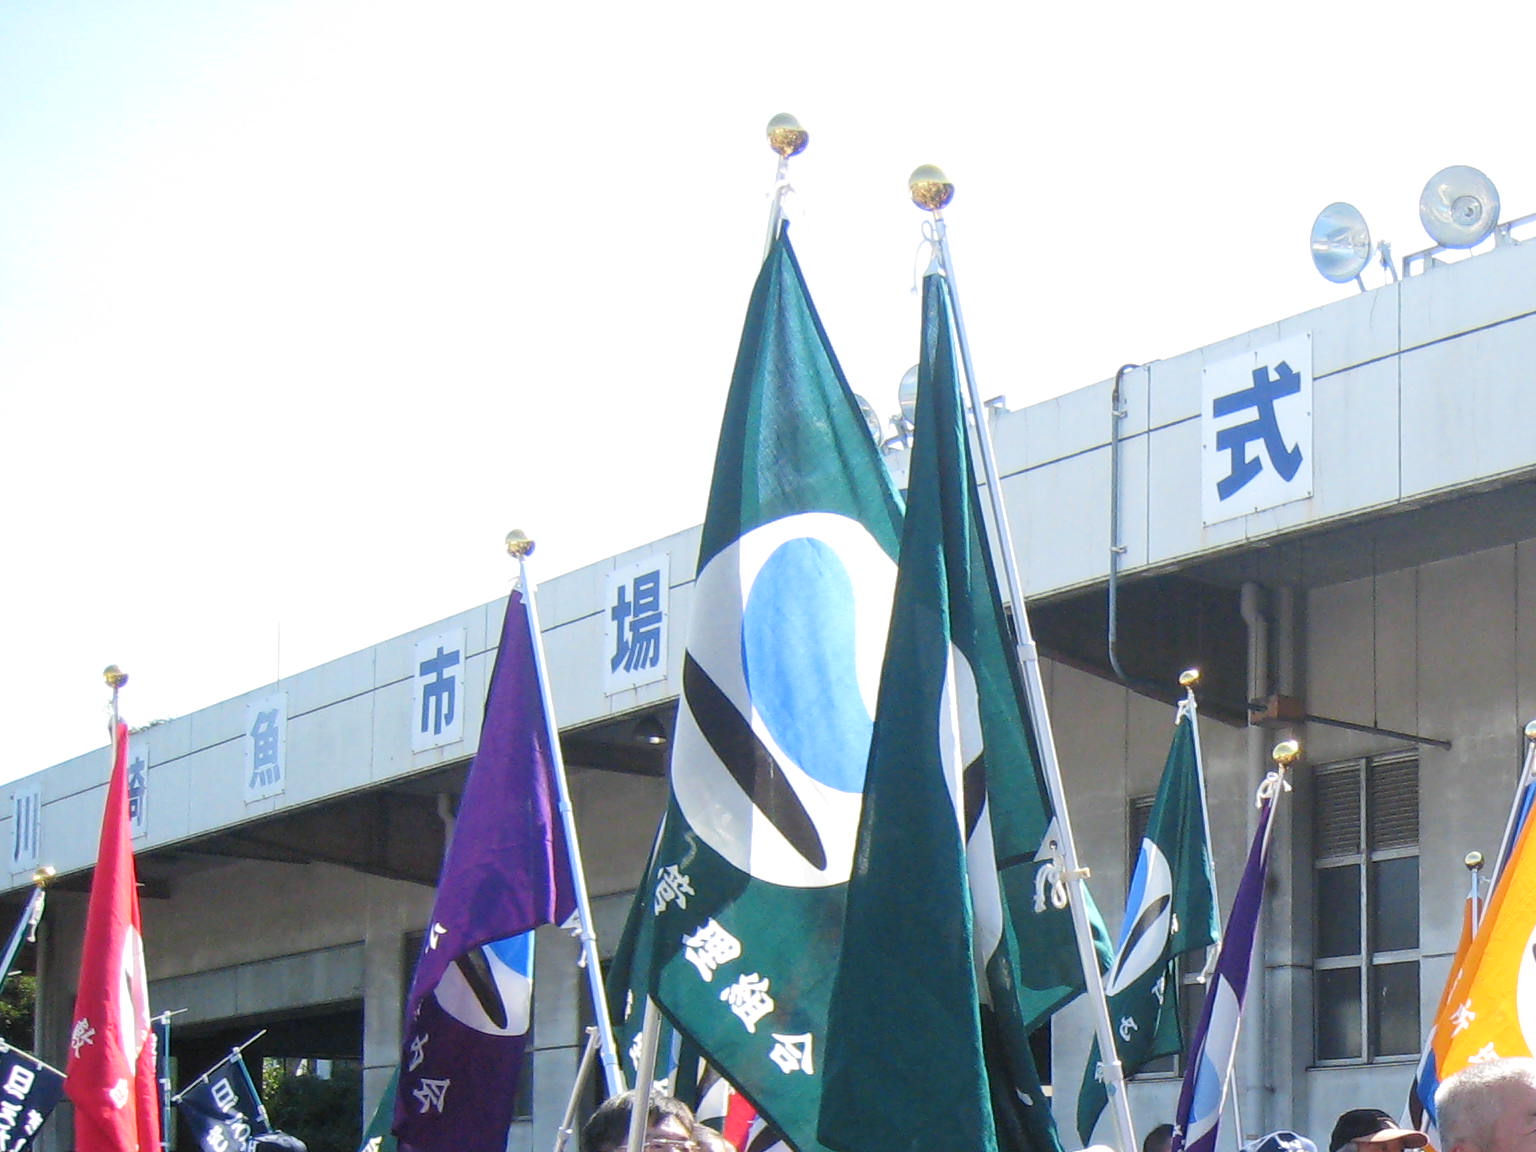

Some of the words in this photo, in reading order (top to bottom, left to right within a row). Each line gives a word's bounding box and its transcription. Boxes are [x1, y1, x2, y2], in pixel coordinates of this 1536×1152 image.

[248, 707, 281, 790] 魚
[419, 646, 460, 736] 市
[611, 569, 663, 674] 場
[1213, 360, 1302, 501] 式
